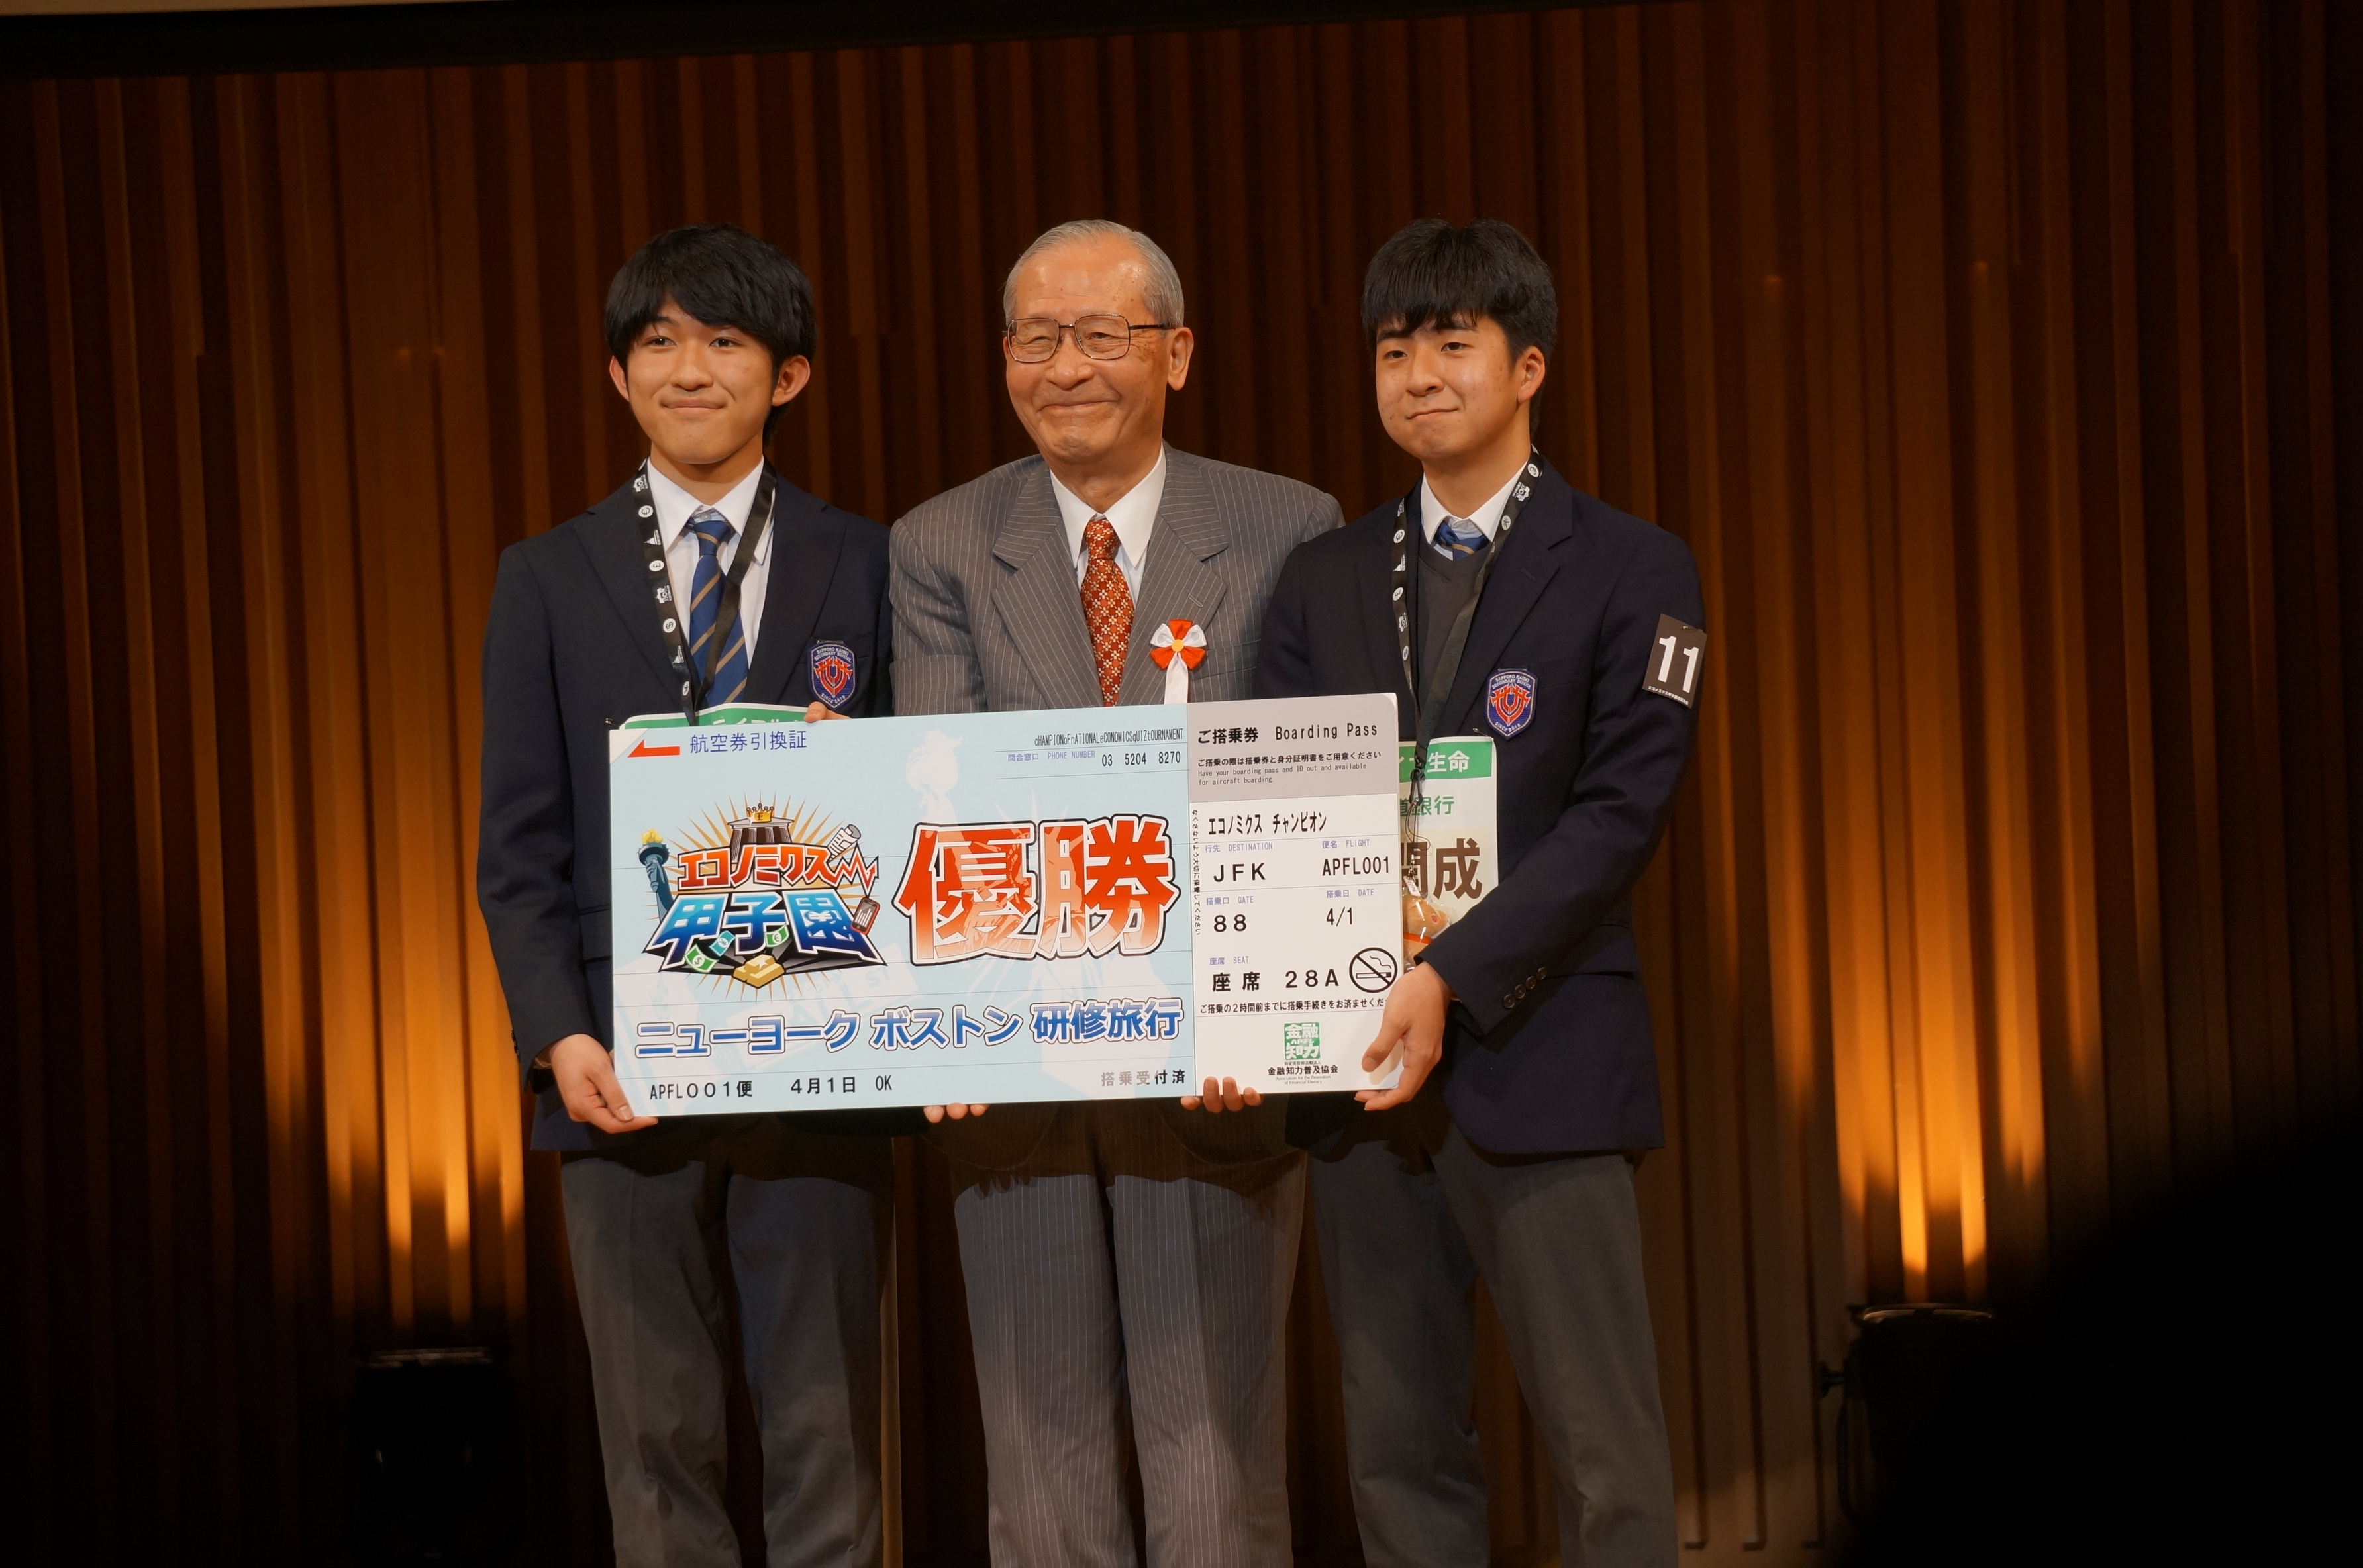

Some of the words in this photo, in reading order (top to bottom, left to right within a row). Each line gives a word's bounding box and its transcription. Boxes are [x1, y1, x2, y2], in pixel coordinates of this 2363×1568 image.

[1658, 636, 1699, 693] 11
[821, 693, 834, 703] SINCE
[689, 730, 808, 754] 航空券引換証
[1197, 727, 1259, 744] ご搭乗券
[1276, 724, 1338, 740] Boarding
[1346, 722, 1378, 737] Pass
[1071, 750, 1095, 759] NUMBER
[1101, 754, 1113, 767] 03
[1125, 752, 1147, 766] 5204
[1158, 751, 1181, 764] 8270
[1232, 767, 1262, 776] boarding
[1334, 762, 1367, 771] available
[1212, 777, 1240, 785] aircraft
[1208, 813, 1263, 836] エコノミクス
[1272, 811, 1327, 834] チャンピオン
[1205, 844, 1221, 854] 行先
[1228, 842, 1273, 852] DESTINATION
[1322, 840, 1338, 849] 便名
[1345, 838, 1370, 848] FLIGHT
[678, 844, 841, 891] エコノミクス
[1213, 863, 1266, 882] JFK
[1322, 856, 1389, 877] APFL001
[894, 814, 1183, 965] 優勝
[1326, 889, 1350, 899] 搭乗日
[1358, 888, 1375, 897] DATE
[1205, 897, 1230, 906] 搭乗口
[1237, 895, 1254, 904] GATE
[1213, 914, 1248, 933] 88
[1326, 906, 1353, 927] 4/1
[644, 890, 887, 971] 甲子園
[1209, 957, 1225, 965] 座席
[1212, 971, 1261, 992] 座席
[1285, 969, 1340, 989] 28A
[636, 1010, 861, 1057] ニューヨーク
[869, 1004, 1023, 1050] ボストン
[1031, 997, 1185, 1044] 研修旅行
[1285, 1023, 1319, 1039] 金融
[1286, 1042, 1319, 1059] 知力
[1101, 1069, 1185, 1087] 搭乗受付済
[1268, 1065, 1338, 1076] 金融知力普及協会
[790, 1076, 856, 1095] 4月1日
[875, 1075, 893, 1091] OK
